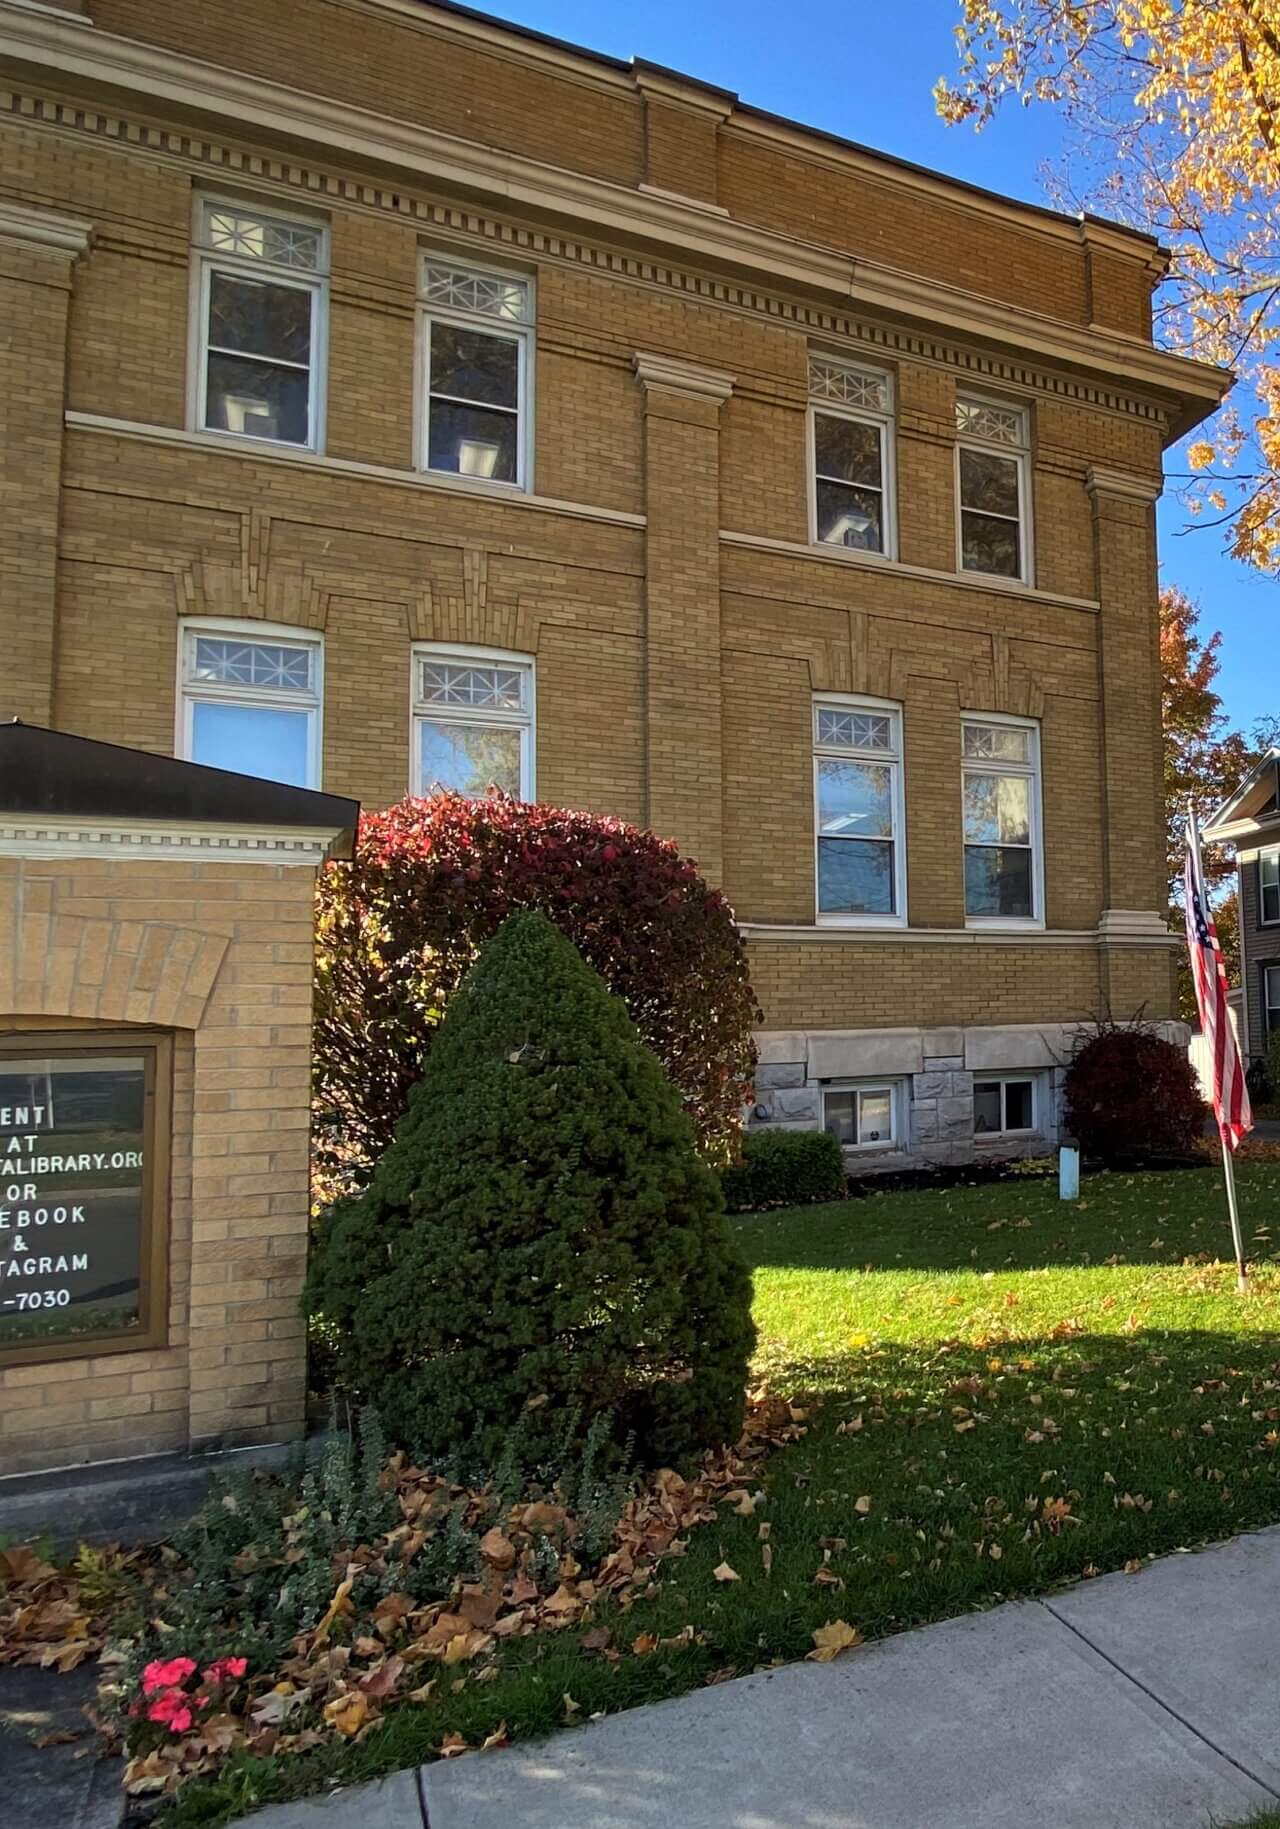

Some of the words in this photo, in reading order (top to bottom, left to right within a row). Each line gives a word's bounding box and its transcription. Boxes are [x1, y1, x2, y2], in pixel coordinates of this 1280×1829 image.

[7, 1135, 38, 1153] AT
[6, 1183, 37, 1201] OR
[13, 1235, 29, 1252] &
